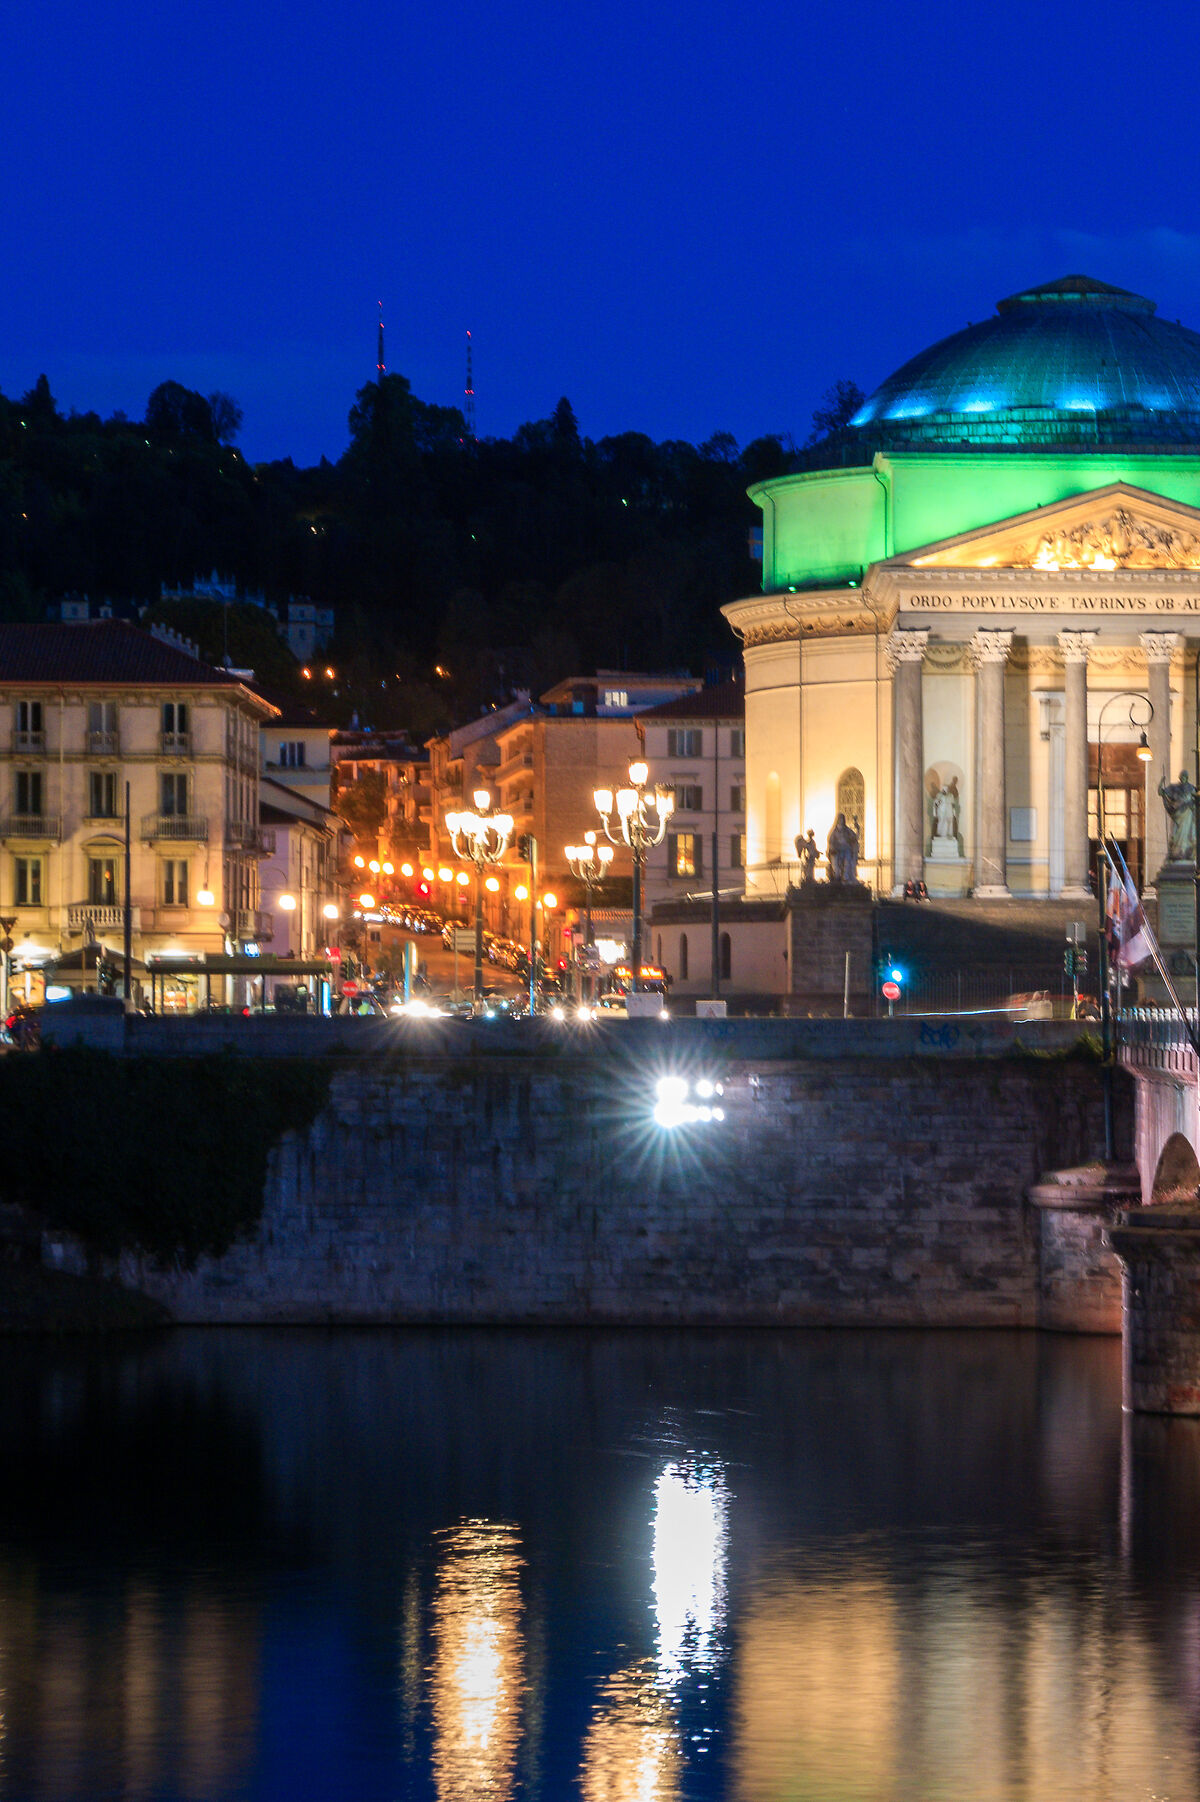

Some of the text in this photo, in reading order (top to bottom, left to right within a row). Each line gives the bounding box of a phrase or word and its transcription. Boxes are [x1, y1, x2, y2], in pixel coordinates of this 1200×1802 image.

[910, 595, 952, 608] ORDO
[962, 596, 1059, 611] POPVLVSQVE
[1068, 597, 1146, 610] TAVRINVS
[1155, 598, 1174, 610] OB
